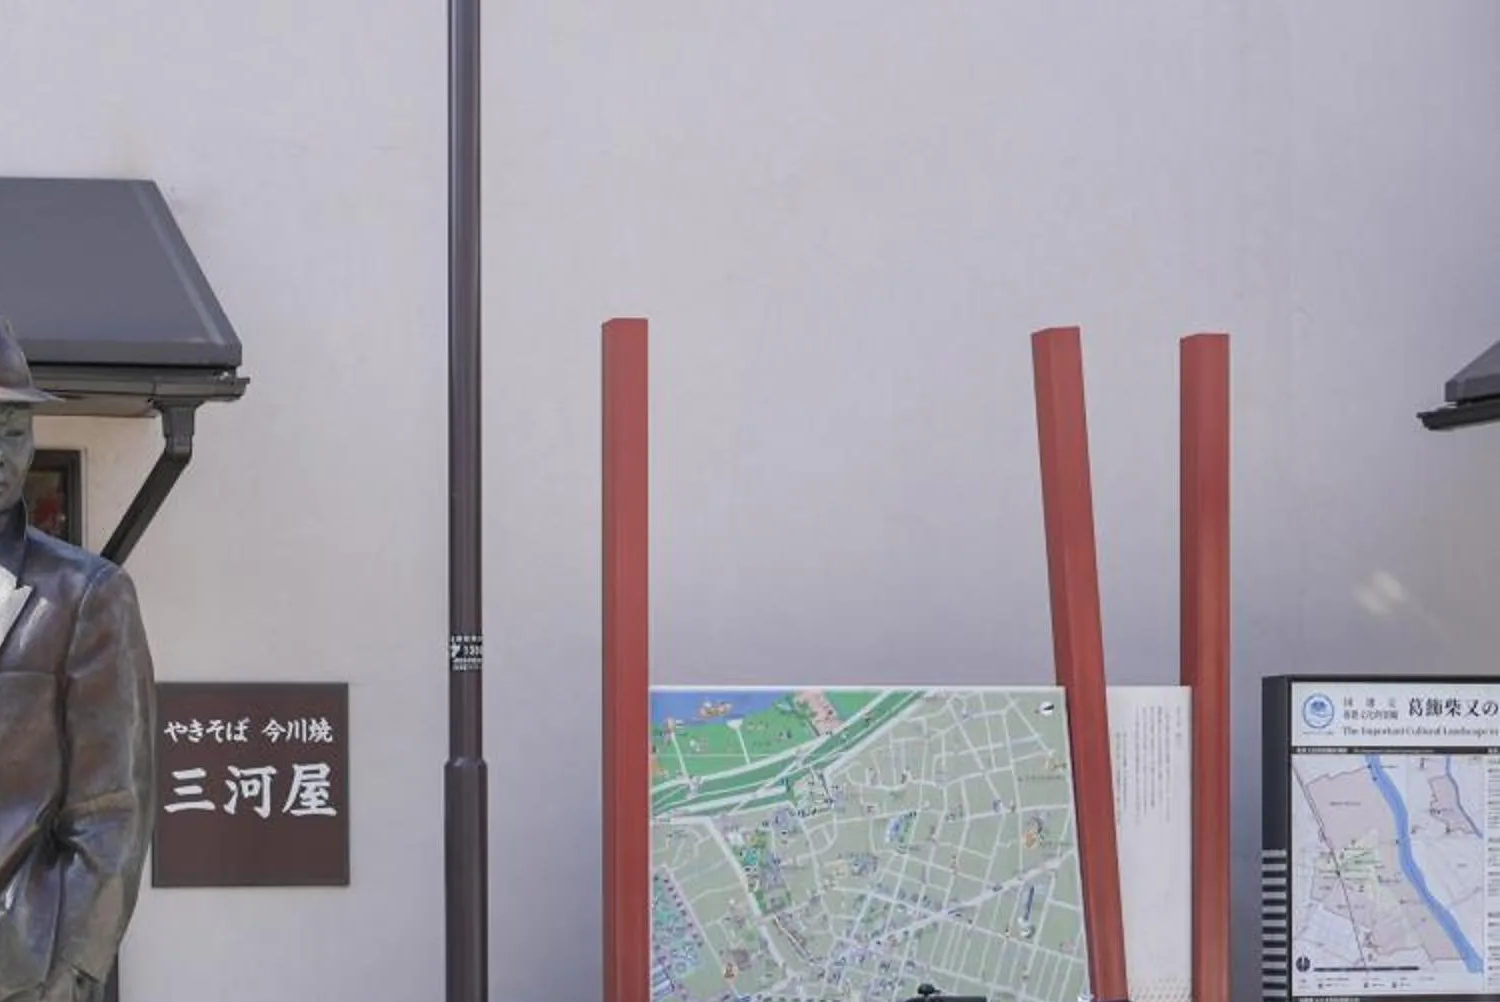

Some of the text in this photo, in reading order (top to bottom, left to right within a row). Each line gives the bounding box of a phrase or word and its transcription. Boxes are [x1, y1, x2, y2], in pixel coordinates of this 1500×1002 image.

[163, 717, 333, 743] やきそば 今川焼
[163, 763, 338, 819] 三河屋
